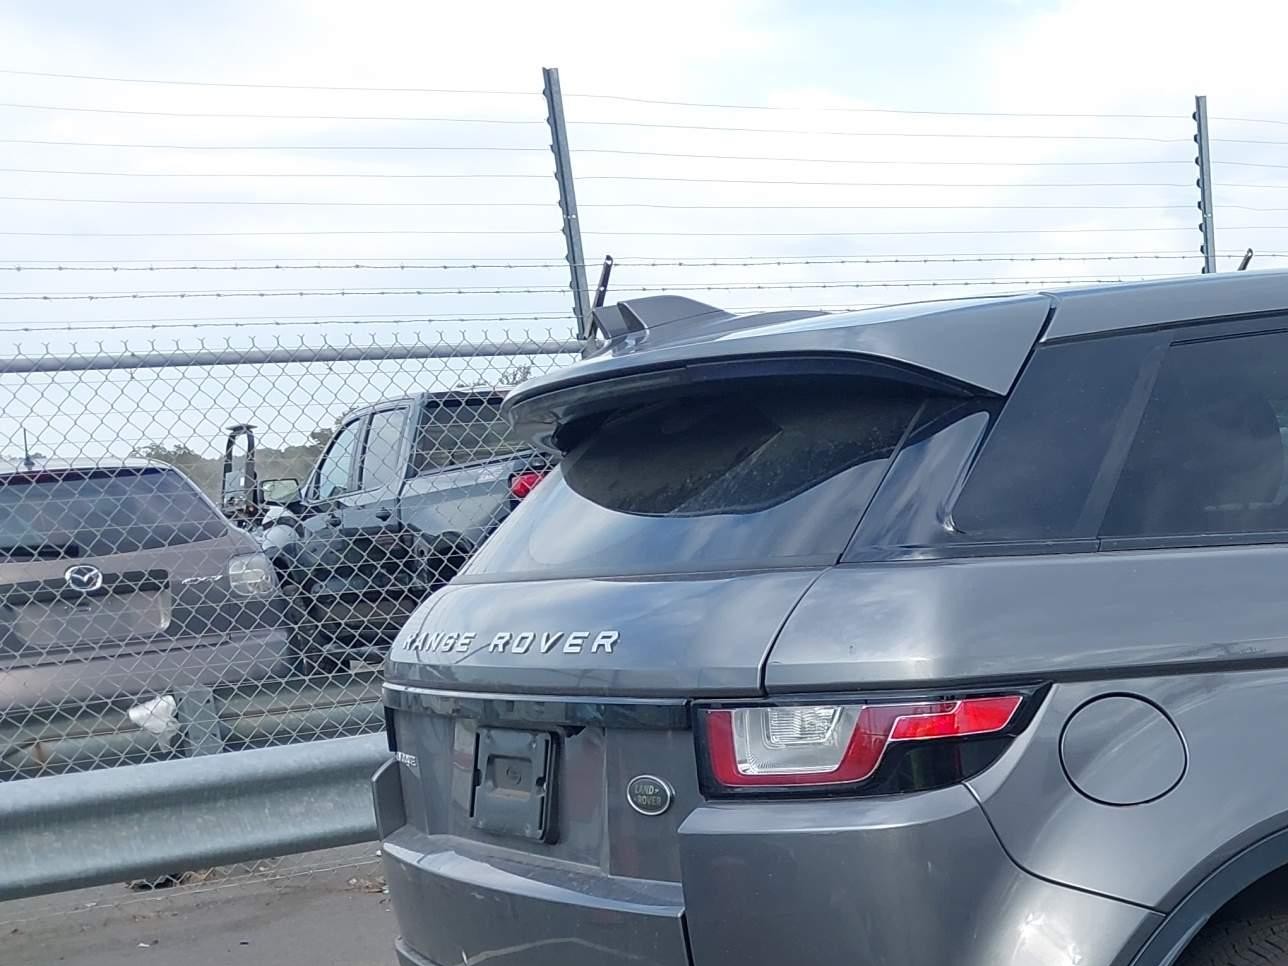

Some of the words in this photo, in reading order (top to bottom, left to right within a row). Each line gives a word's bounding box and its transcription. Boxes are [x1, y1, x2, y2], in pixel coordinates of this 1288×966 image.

[402, 631, 477, 652] RANGE
[488, 630, 621, 654] ROVER
[634, 783, 655, 795] LAND
